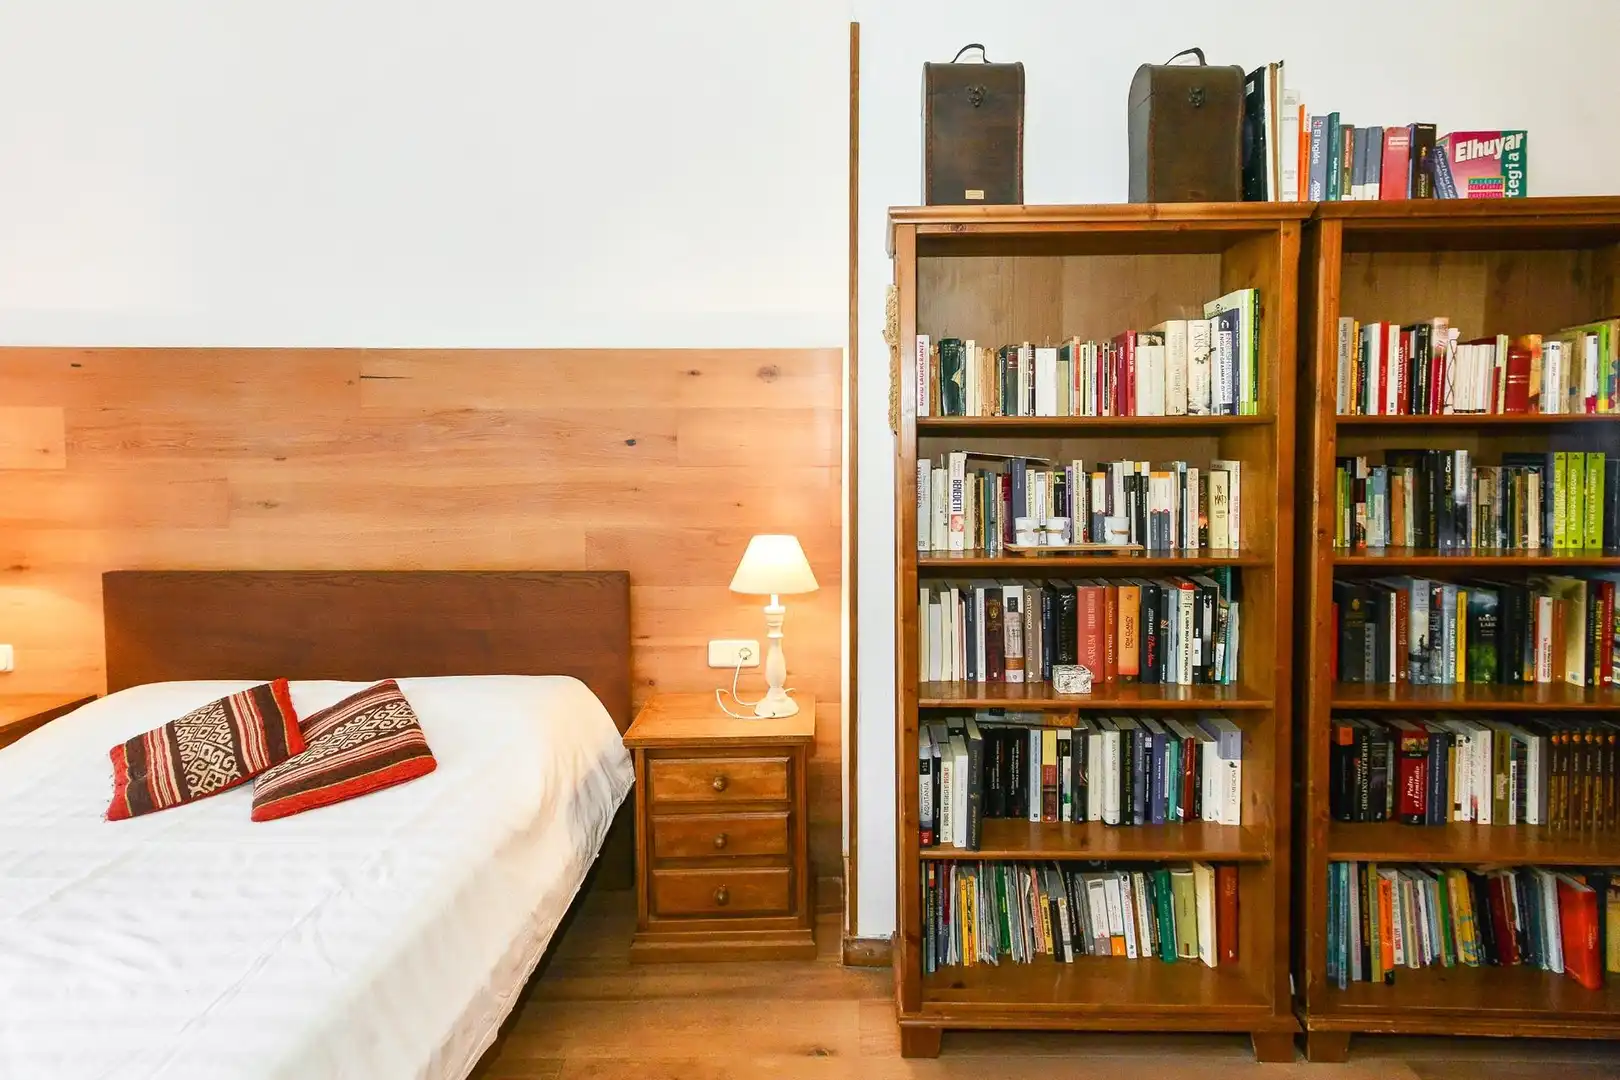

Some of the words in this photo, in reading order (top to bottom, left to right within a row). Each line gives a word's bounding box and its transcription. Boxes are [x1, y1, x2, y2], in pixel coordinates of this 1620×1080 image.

[1455, 132, 1523, 163] Elhuyar
[1339, 323, 1347, 342] Carlos
[1339, 343, 1348, 357] Juan
[952, 479, 963, 512] BENEDETTI
[1087, 634, 1096, 667] SARUM
[1361, 778, 1369, 810] OXFORD
[1406, 775, 1414, 797] Pedro
[1413, 765, 1421, 799] Ermitaño
[922, 780, 930, 817] AQUITANIA
